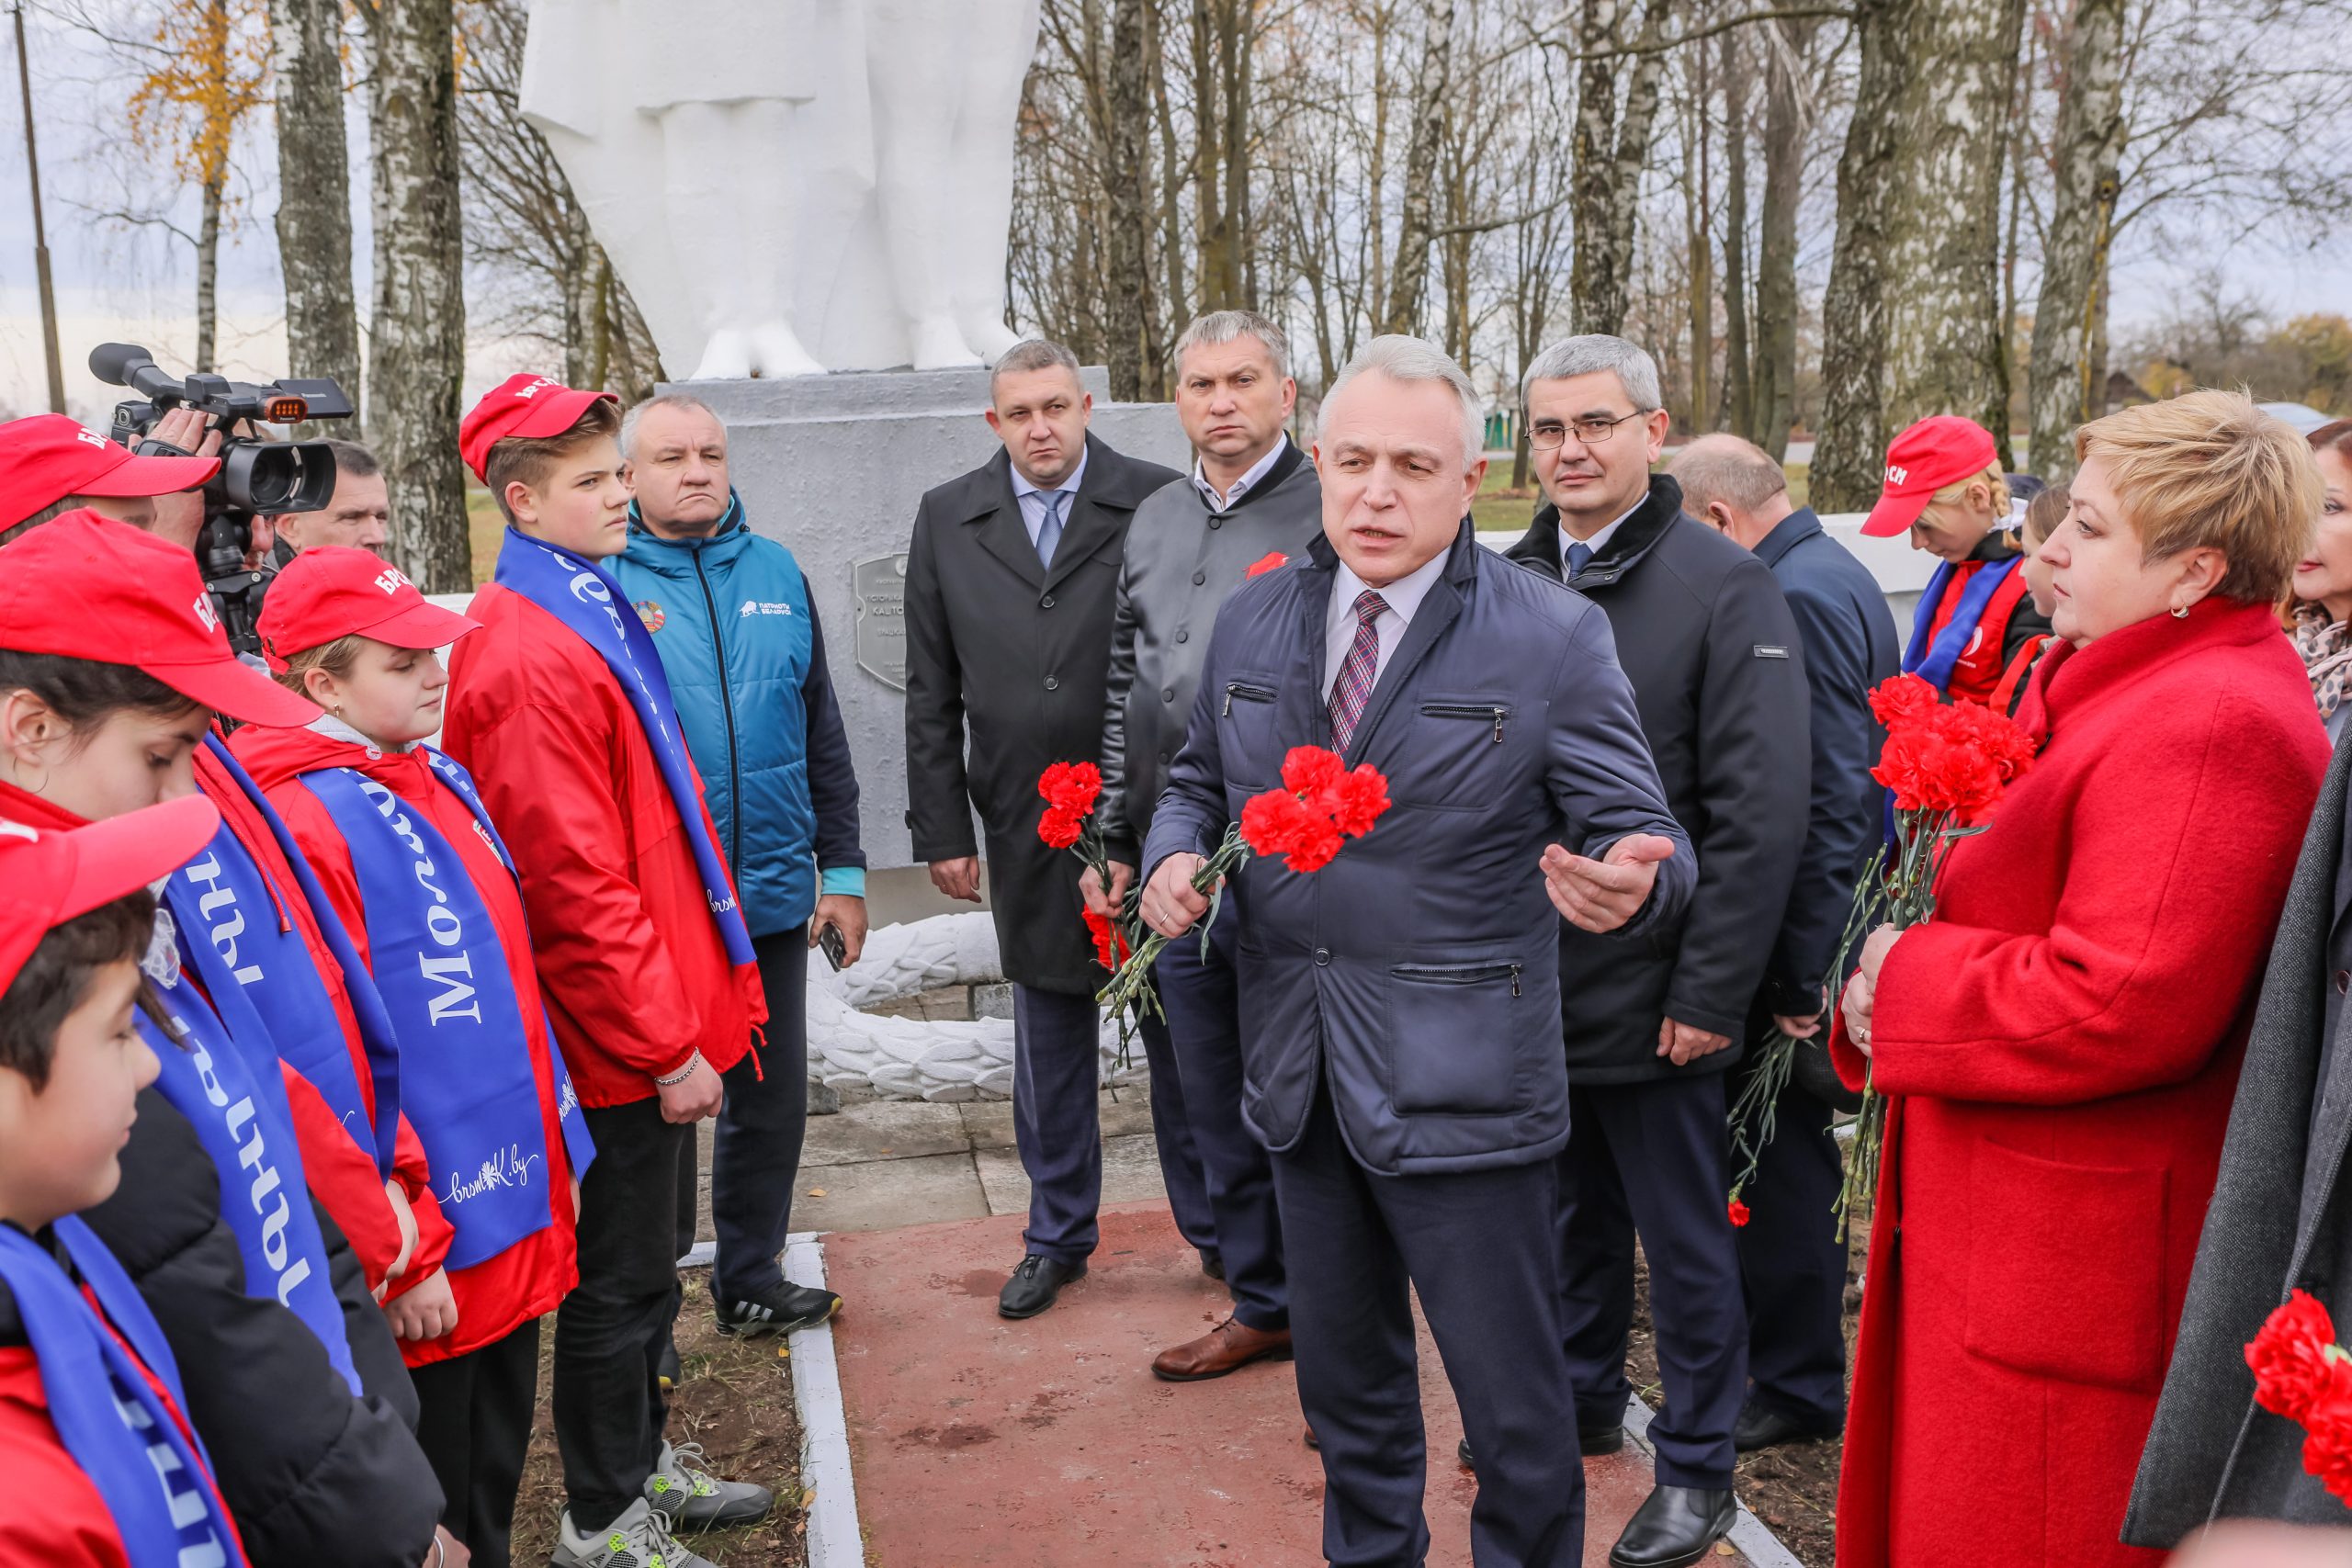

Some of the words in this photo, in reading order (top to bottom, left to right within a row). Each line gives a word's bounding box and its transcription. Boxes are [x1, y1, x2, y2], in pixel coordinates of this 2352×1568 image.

[77, 427, 109, 450] БР
[374, 568, 416, 596] БРС
[193, 592, 220, 634] БР
